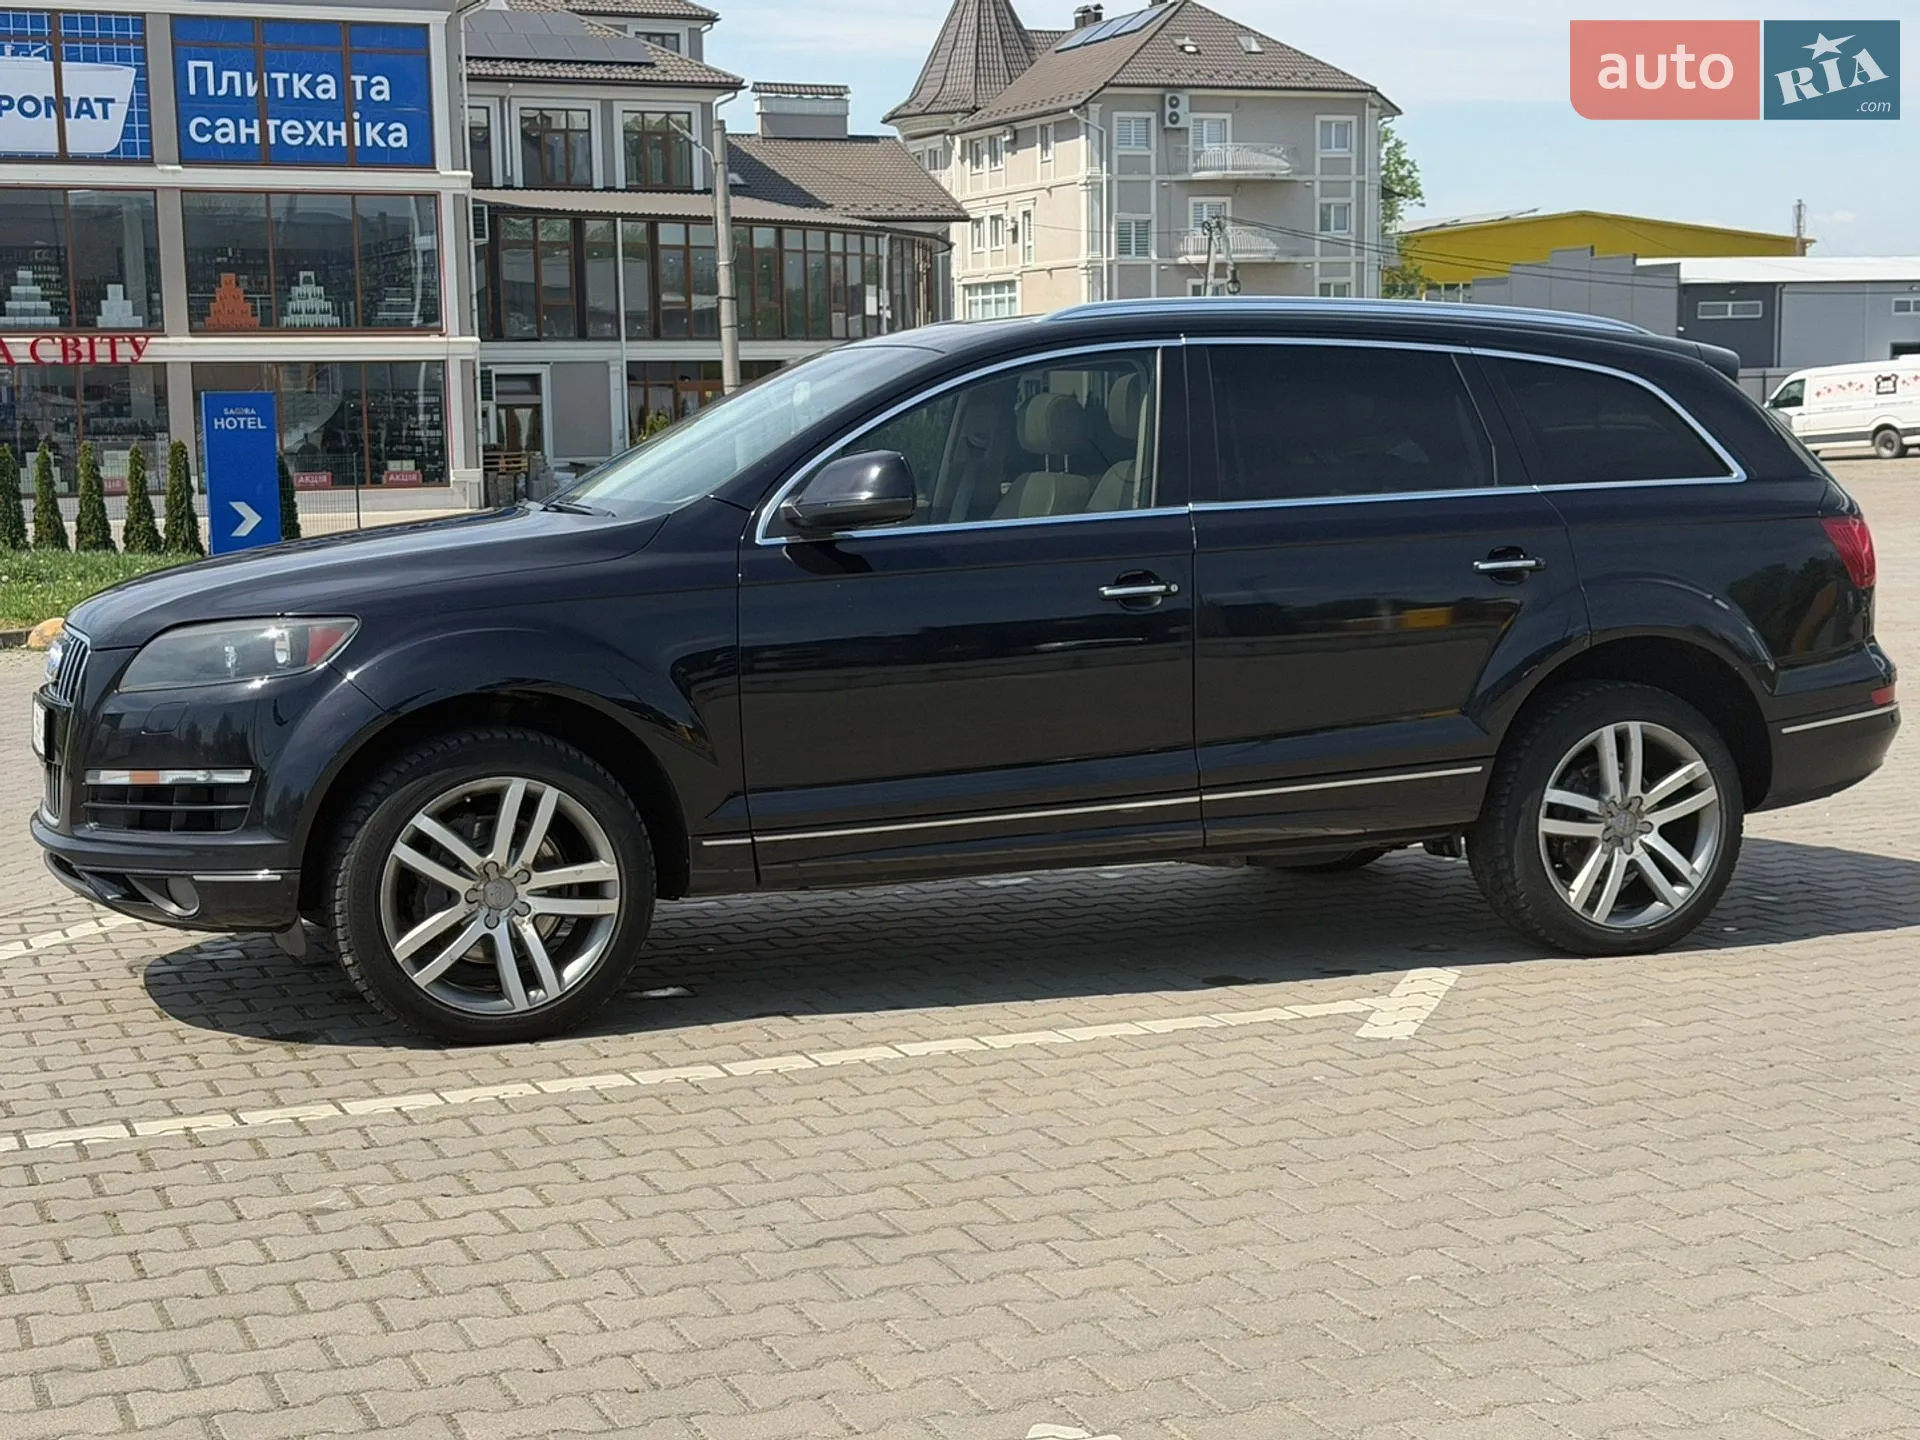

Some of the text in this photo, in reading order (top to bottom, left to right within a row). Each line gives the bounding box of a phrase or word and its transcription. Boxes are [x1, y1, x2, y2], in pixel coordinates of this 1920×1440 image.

[187, 60, 391, 101] Плитка та
[188, 111, 409, 148] сантехніка
[29, 335, 150, 367] СВІТУ
[214, 416, 267, 430] HOTEL
